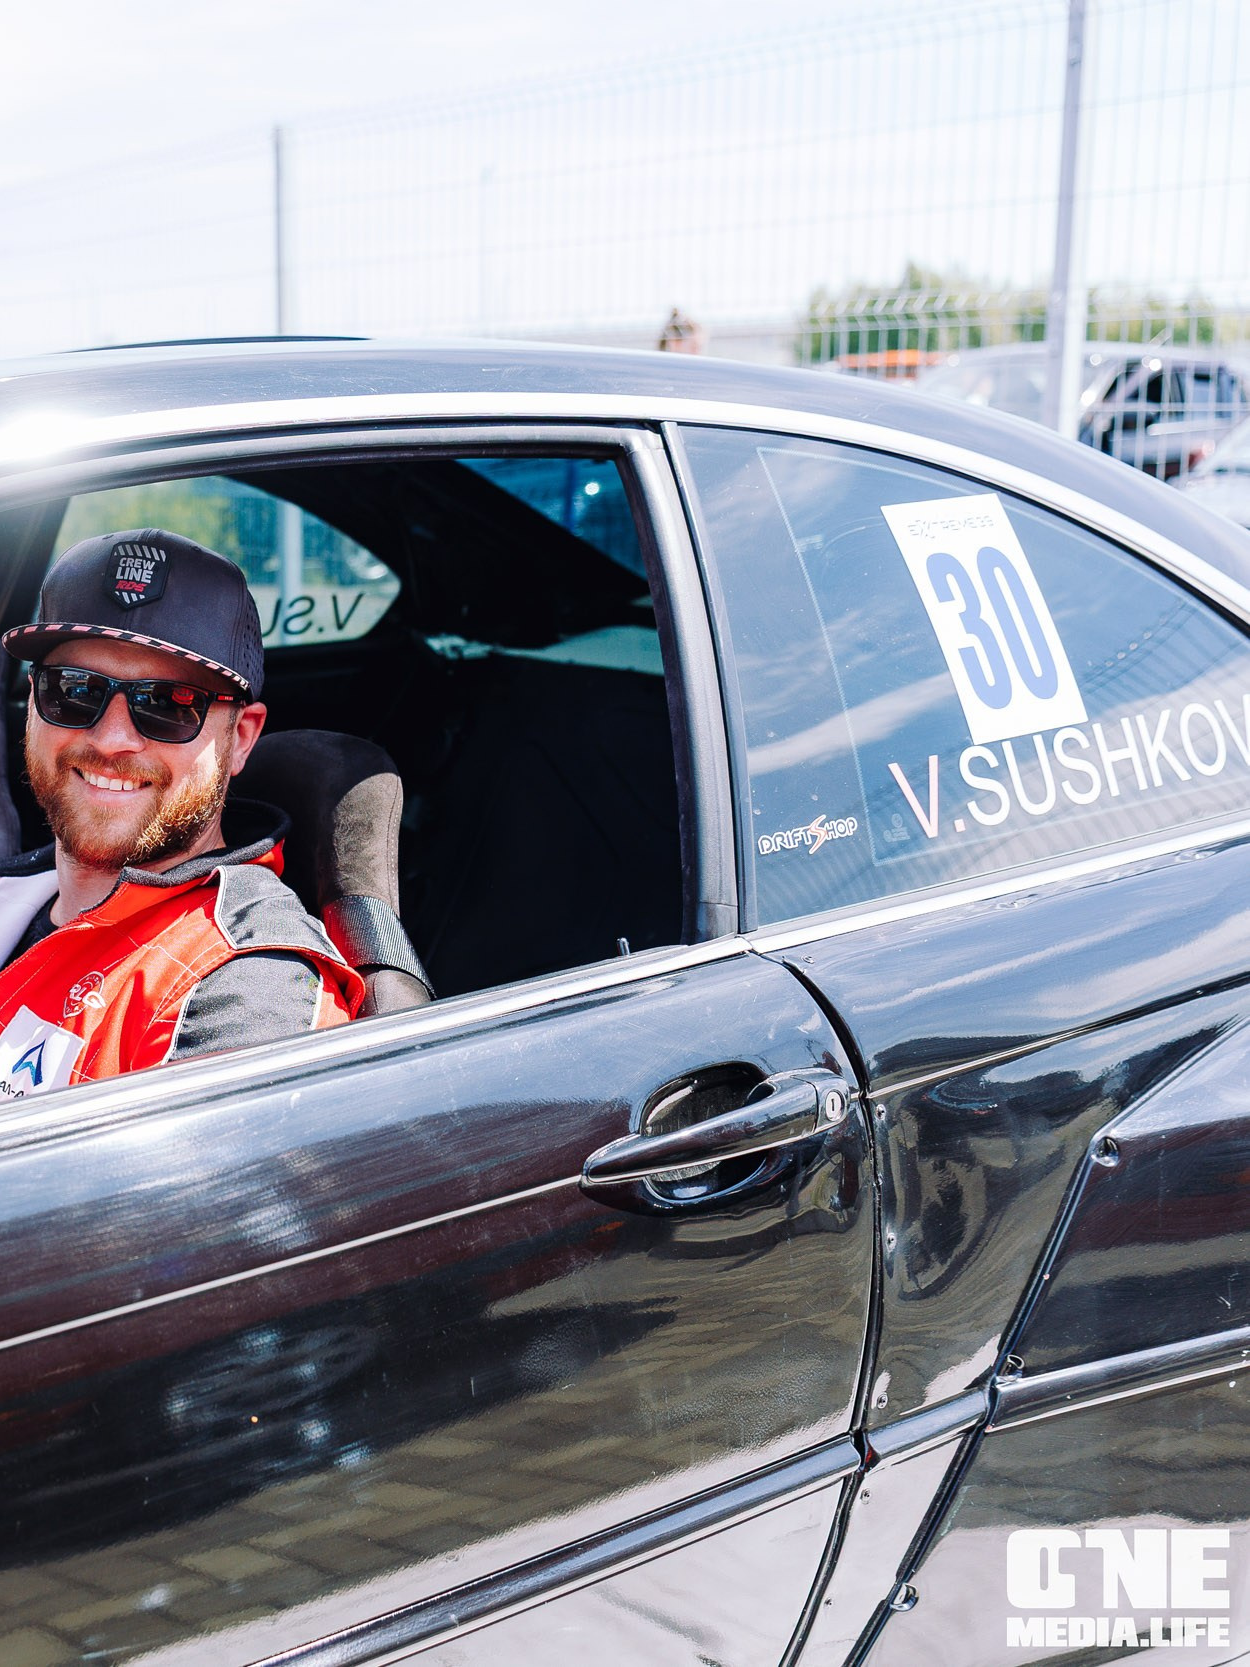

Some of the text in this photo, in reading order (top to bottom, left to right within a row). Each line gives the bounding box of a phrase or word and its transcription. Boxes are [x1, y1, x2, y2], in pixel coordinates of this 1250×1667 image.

[119, 557, 156, 571] CREW
[115, 566, 154, 584] LINE
[115, 579, 147, 593] RDS
[926, 546, 1059, 710] 30
